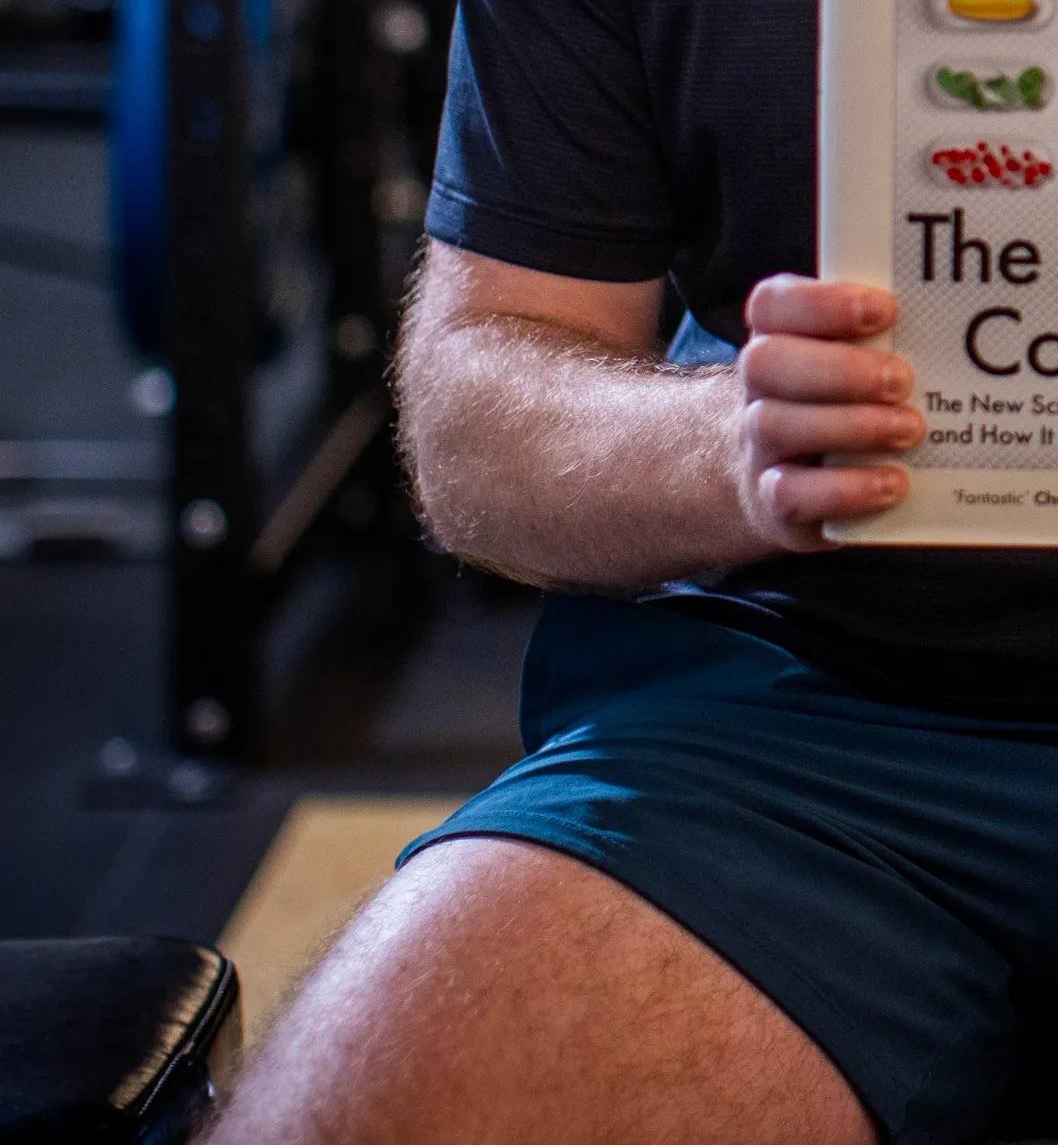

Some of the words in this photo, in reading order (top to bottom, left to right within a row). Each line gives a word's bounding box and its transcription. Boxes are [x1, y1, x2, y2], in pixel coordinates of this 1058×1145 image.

[907, 206, 1042, 285] The
[924, 391, 963, 414] The
[970, 393, 1025, 414] New
[928, 422, 973, 445] and
[980, 424, 1034, 445] How
[1040, 425, 1055, 445] It
